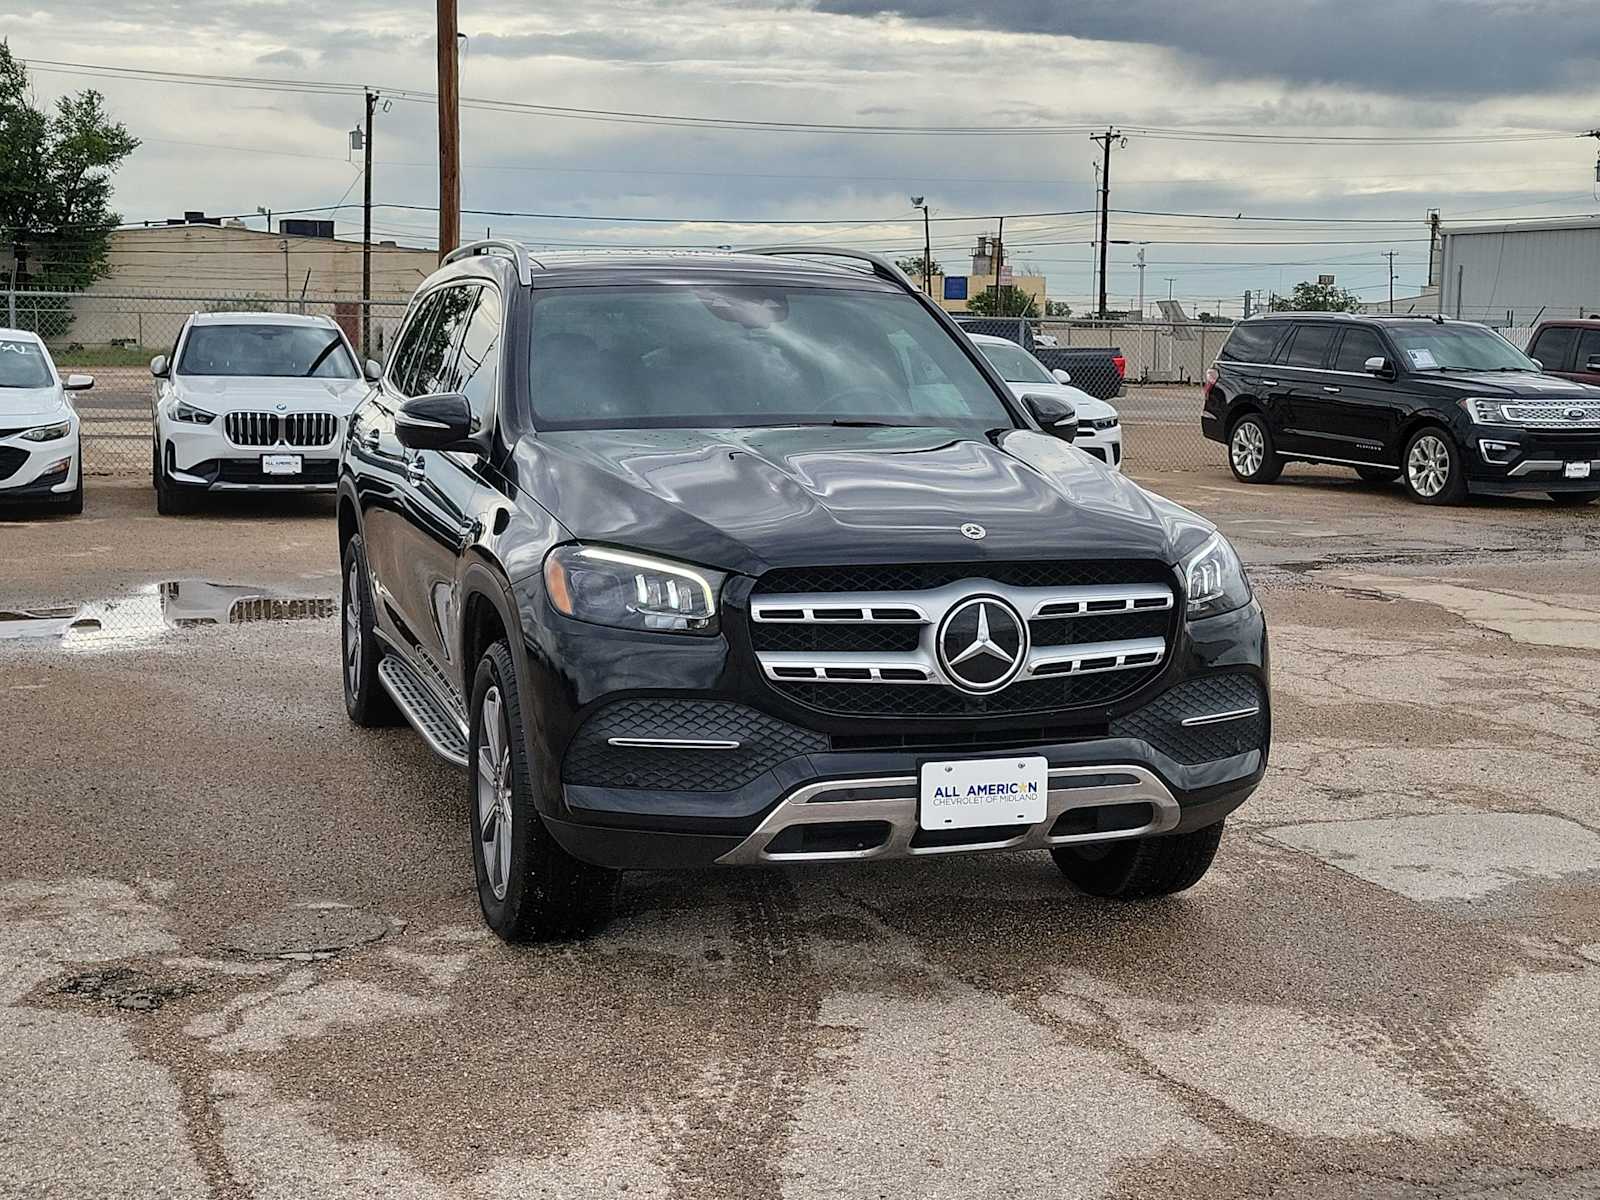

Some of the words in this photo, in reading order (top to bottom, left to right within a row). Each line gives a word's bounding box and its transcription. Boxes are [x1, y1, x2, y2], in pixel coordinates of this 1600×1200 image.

[934, 786, 960, 798] ALL
[966, 781, 1037, 797] AMERICN
[933, 796, 983, 806] CHEVROLET
[985, 795, 998, 804] OF
[999, 793, 1038, 802] MIDLAND
